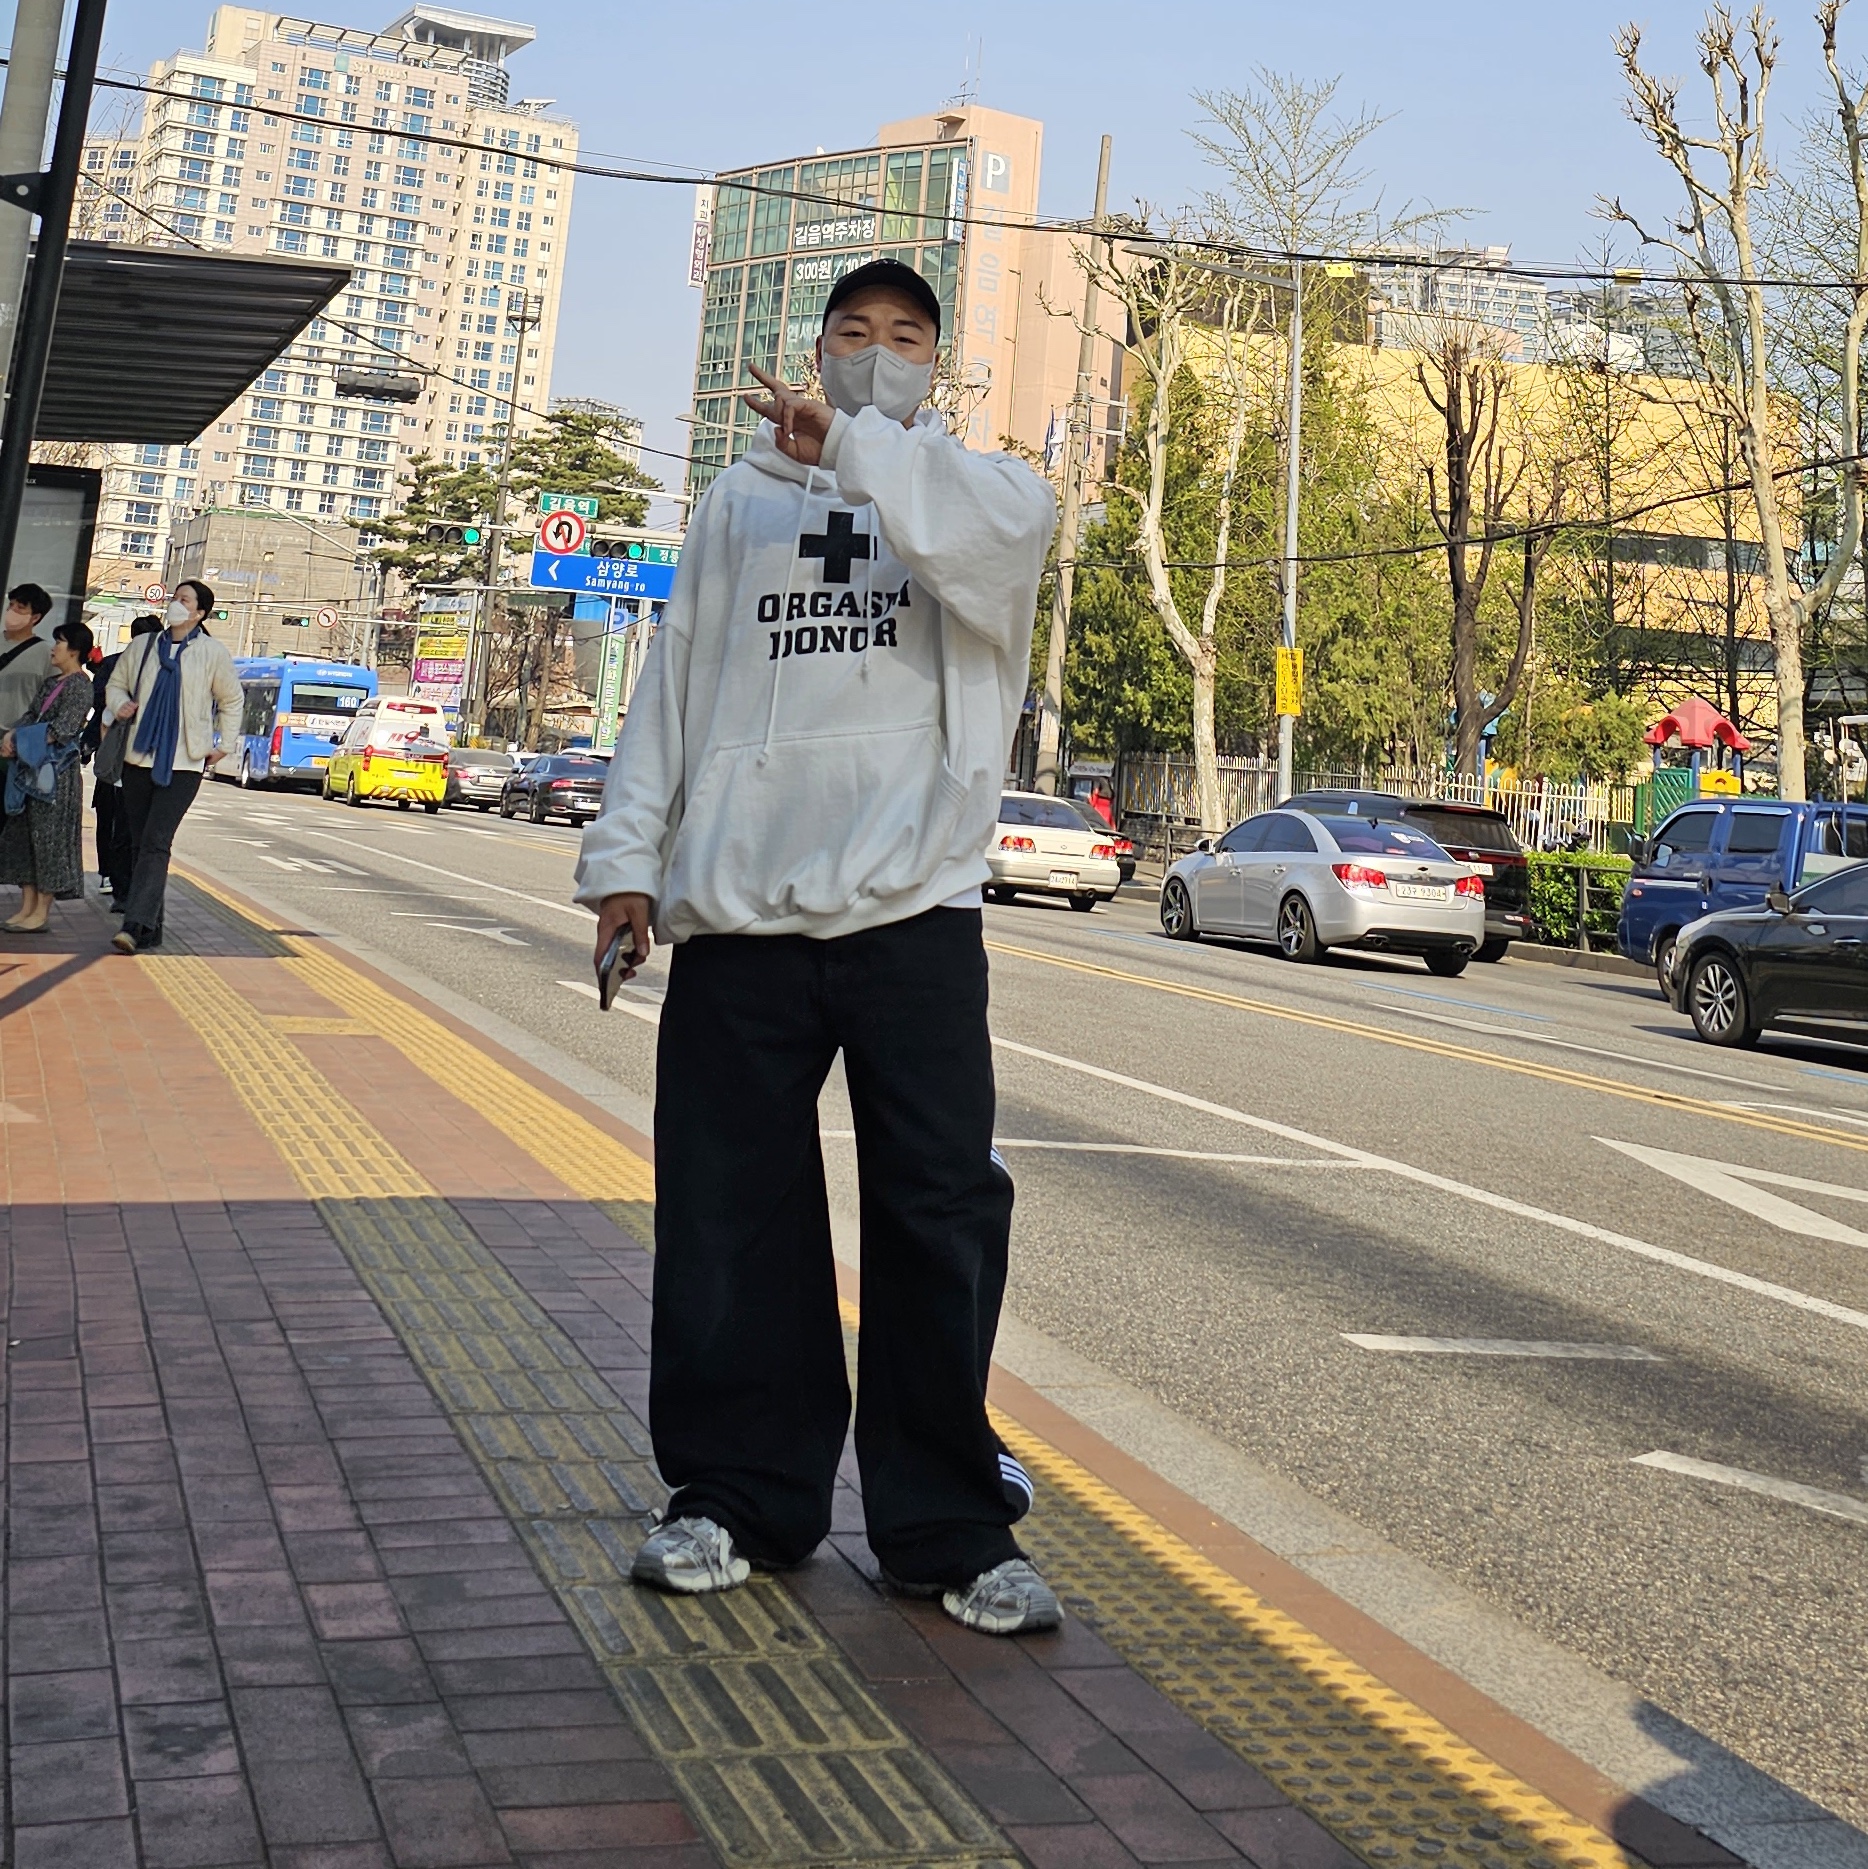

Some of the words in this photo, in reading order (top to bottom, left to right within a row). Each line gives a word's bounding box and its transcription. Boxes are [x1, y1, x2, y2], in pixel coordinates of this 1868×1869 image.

[986, 153, 1006, 189] P
[794, 216, 876, 246] 길음역주차장
[549, 497, 591, 515] 길음역
[597, 560, 638, 579] 삼양로
[585, 575, 646, 592] Samyang-ro
[148, 588, 161, 599] 50
[769, 617, 897, 660] DONOR
[340, 695, 357, 708] 160
